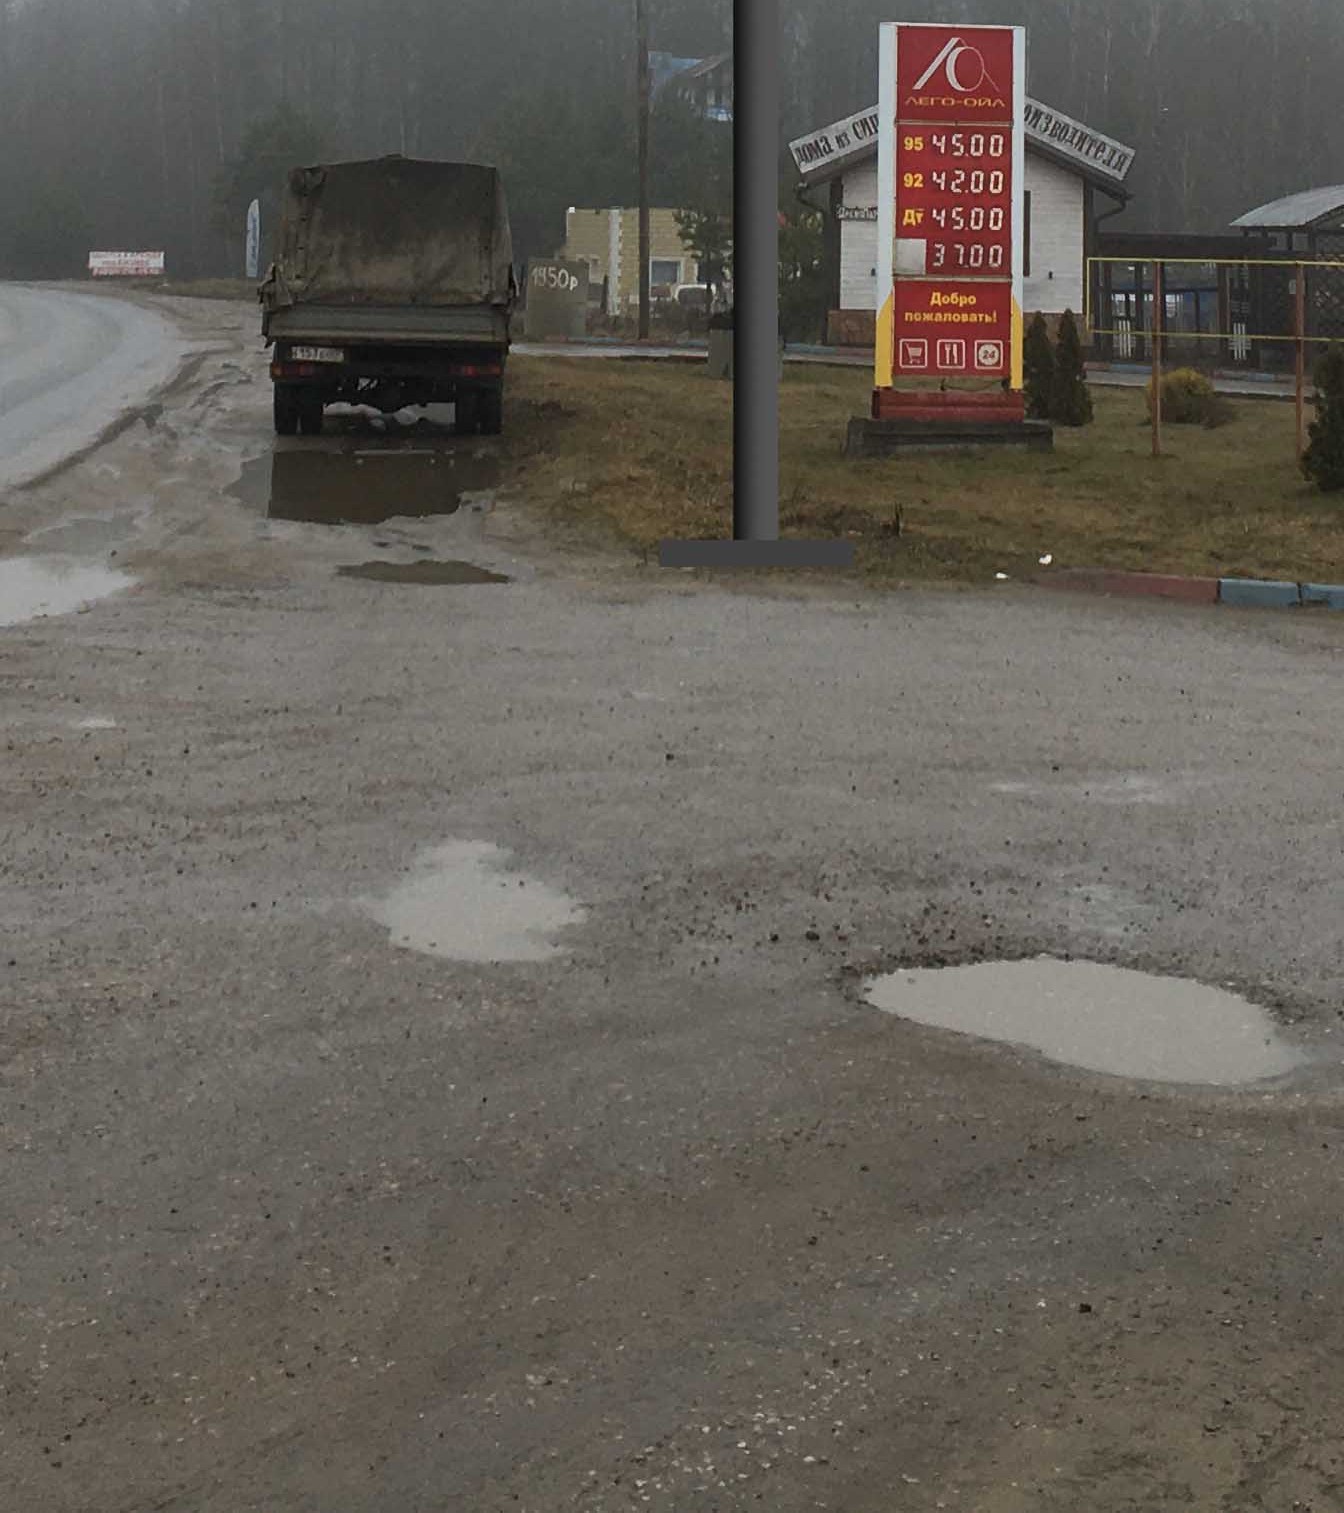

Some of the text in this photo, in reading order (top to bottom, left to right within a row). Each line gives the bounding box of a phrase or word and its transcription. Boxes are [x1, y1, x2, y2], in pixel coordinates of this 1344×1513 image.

[904, 96, 1005, 107] ЛЕГО-ОЙЛ
[903, 134, 1004, 157] 95 45.00
[1024, 104, 1129, 172] оизводителя
[903, 170, 1004, 194] 92 42.00
[932, 207, 1004, 231] 45.00
[932, 243, 1004, 268] 37.00
[930, 291, 977, 308] Добро
[904, 310, 998, 323] пожаловать!
